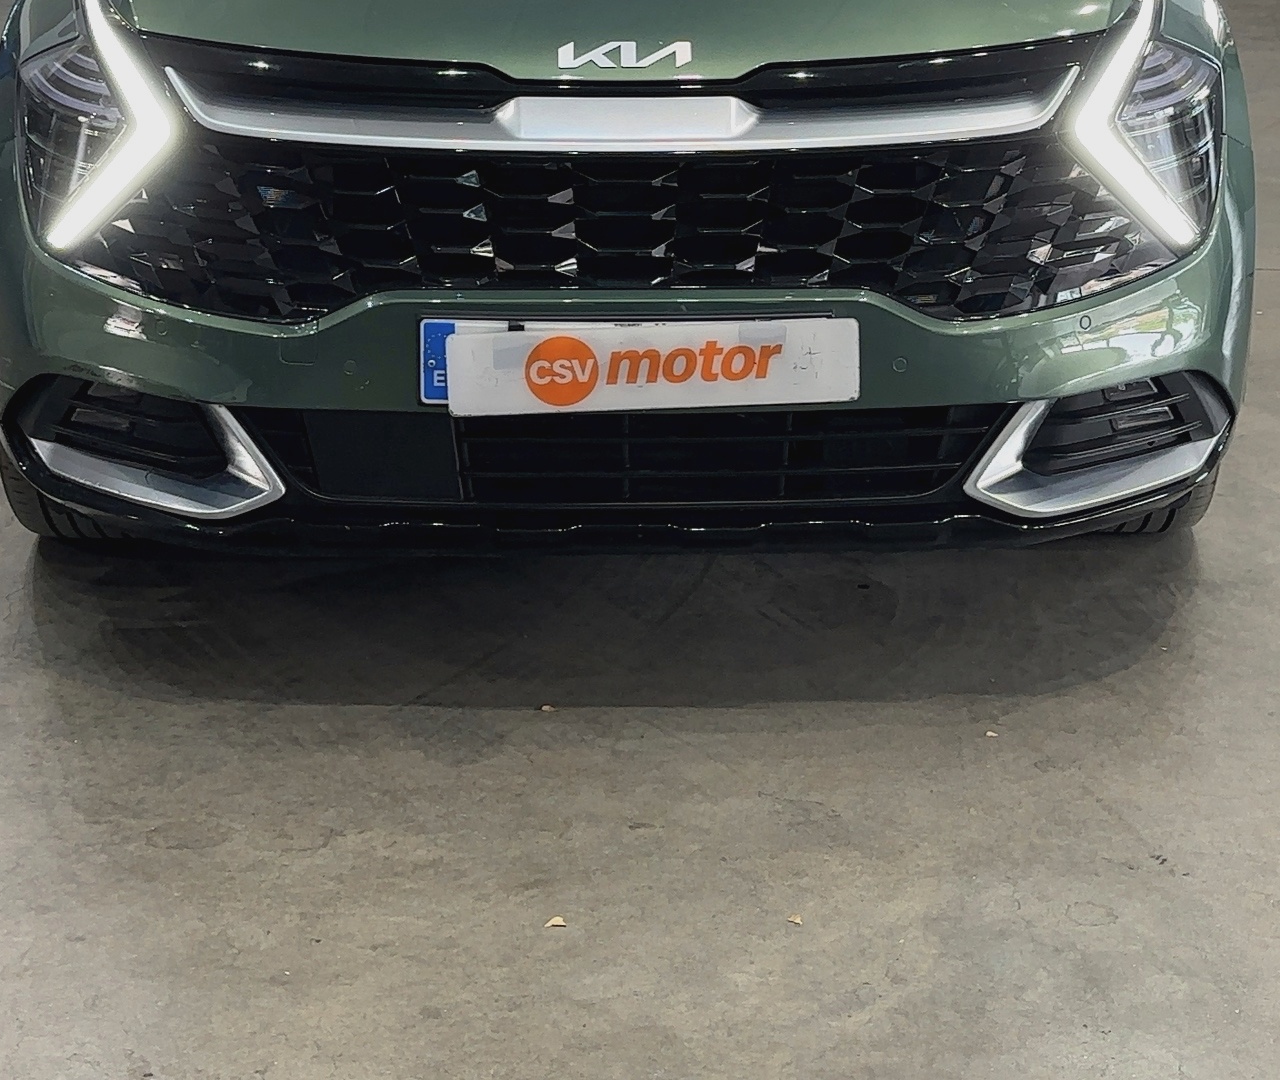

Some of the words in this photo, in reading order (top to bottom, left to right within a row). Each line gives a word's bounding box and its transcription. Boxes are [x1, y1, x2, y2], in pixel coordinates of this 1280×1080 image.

[557, 41, 692, 69] KIA
[529, 358, 595, 386] CSV
[606, 340, 783, 385] motor
[433, 370, 446, 387] E
